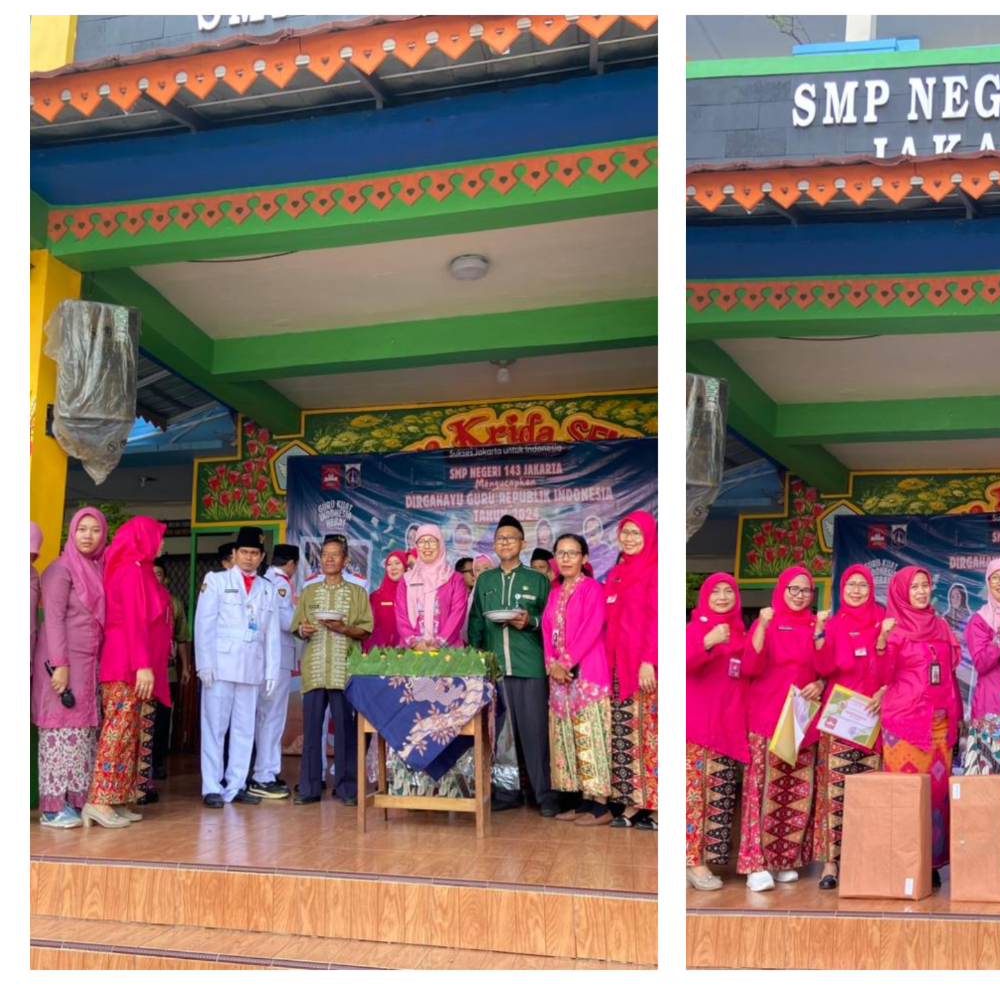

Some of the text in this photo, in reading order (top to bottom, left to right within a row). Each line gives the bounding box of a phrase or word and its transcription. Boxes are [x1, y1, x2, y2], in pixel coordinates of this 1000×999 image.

[792, 79, 891, 128] SMP
[448, 412, 555, 447] Krida
[449, 462, 563, 480] SMP NEGERI 143 JAKARTA
[475, 477, 536, 490] Mengucapkan
[405, 486, 614, 509] DIRGAHAYU GURU REPUBLIK INDONESIA
[318, 501, 335, 513] GURU
[511, 506, 539, 521] 2024
